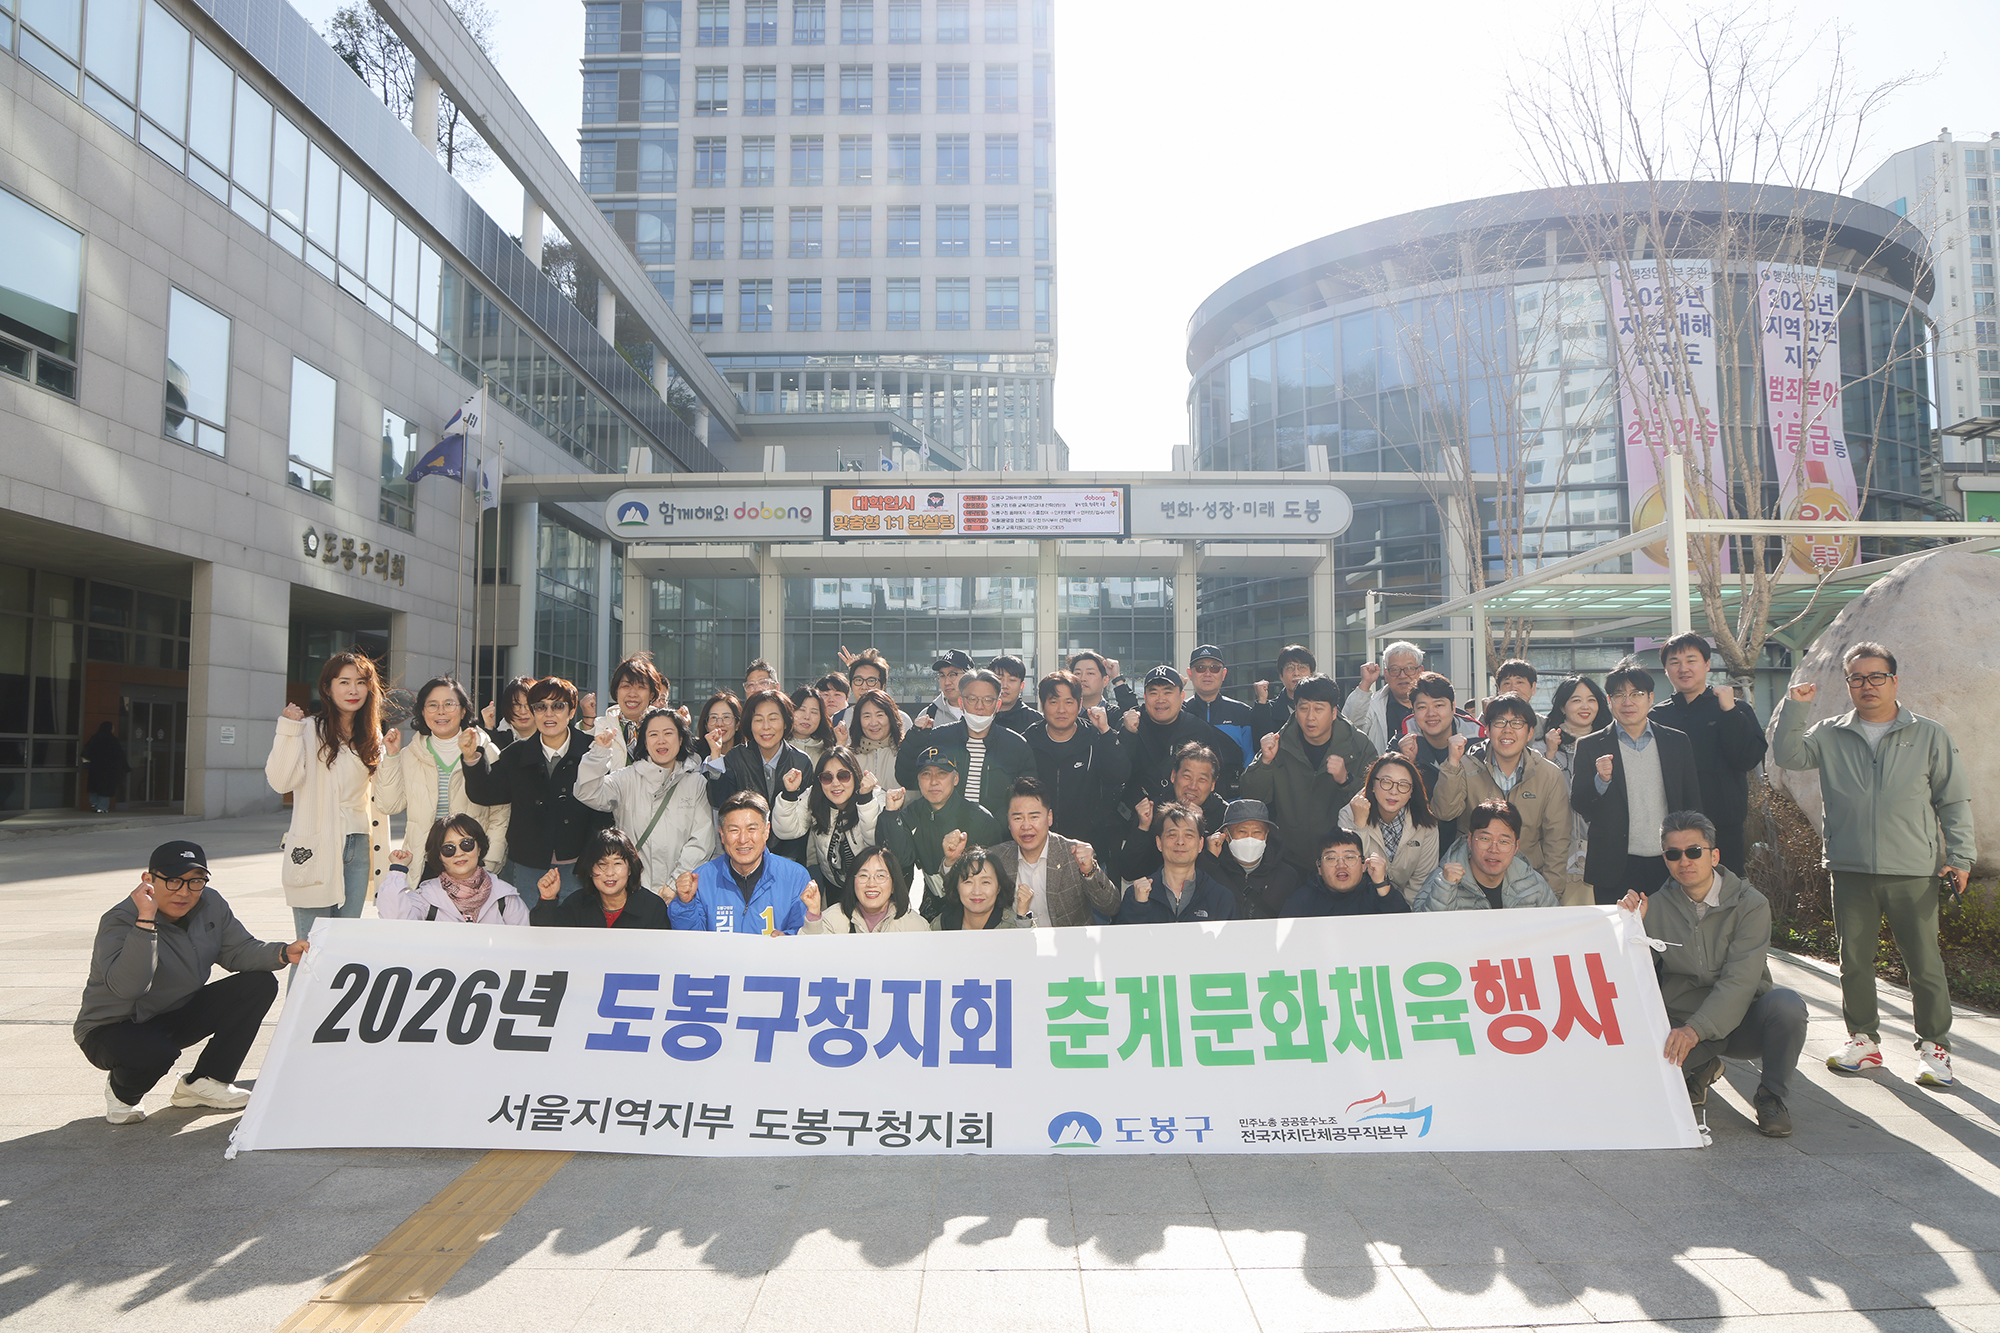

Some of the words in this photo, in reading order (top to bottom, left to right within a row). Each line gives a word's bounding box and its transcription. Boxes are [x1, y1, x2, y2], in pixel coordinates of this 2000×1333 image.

[1765, 315, 1838, 345] 지역안전
[1784, 345, 1822, 370] 지수
[1768, 374, 1838, 409] 범죄분야
[1833, 439, 1847, 460] 등
[852, 495, 915, 511] 대학입시
[1084, 494, 1106, 502] dobong
[659, 501, 729, 525] 함께해요!
[734, 501, 812, 523] dobong
[833, 514, 860, 531] 맞춤형
[884, 515, 904, 530] 1:1
[907, 514, 955, 531] 컨설팅
[1283, 499, 1322, 524] 도봉
[322, 532, 405, 587] 도봉구의회
[1811, 545, 1841, 567] 등급
[929, 748, 939, 759] P
[759, 905, 776, 936] 1
[311, 962, 569, 1053] 2026년
[584, 972, 1013, 1069] 도봉구청지회
[487, 1094, 734, 1141] 서울지역지부
[748, 1108, 994, 1149] 도봉구청지회
[1115, 1115, 1214, 1144] 도봉구
[1239, 1118, 1277, 1128] 민주노총
[1281, 1116, 1338, 1127] 공공운수노조
[1241, 1125, 1409, 1144] 전국자치단체공무직본부
